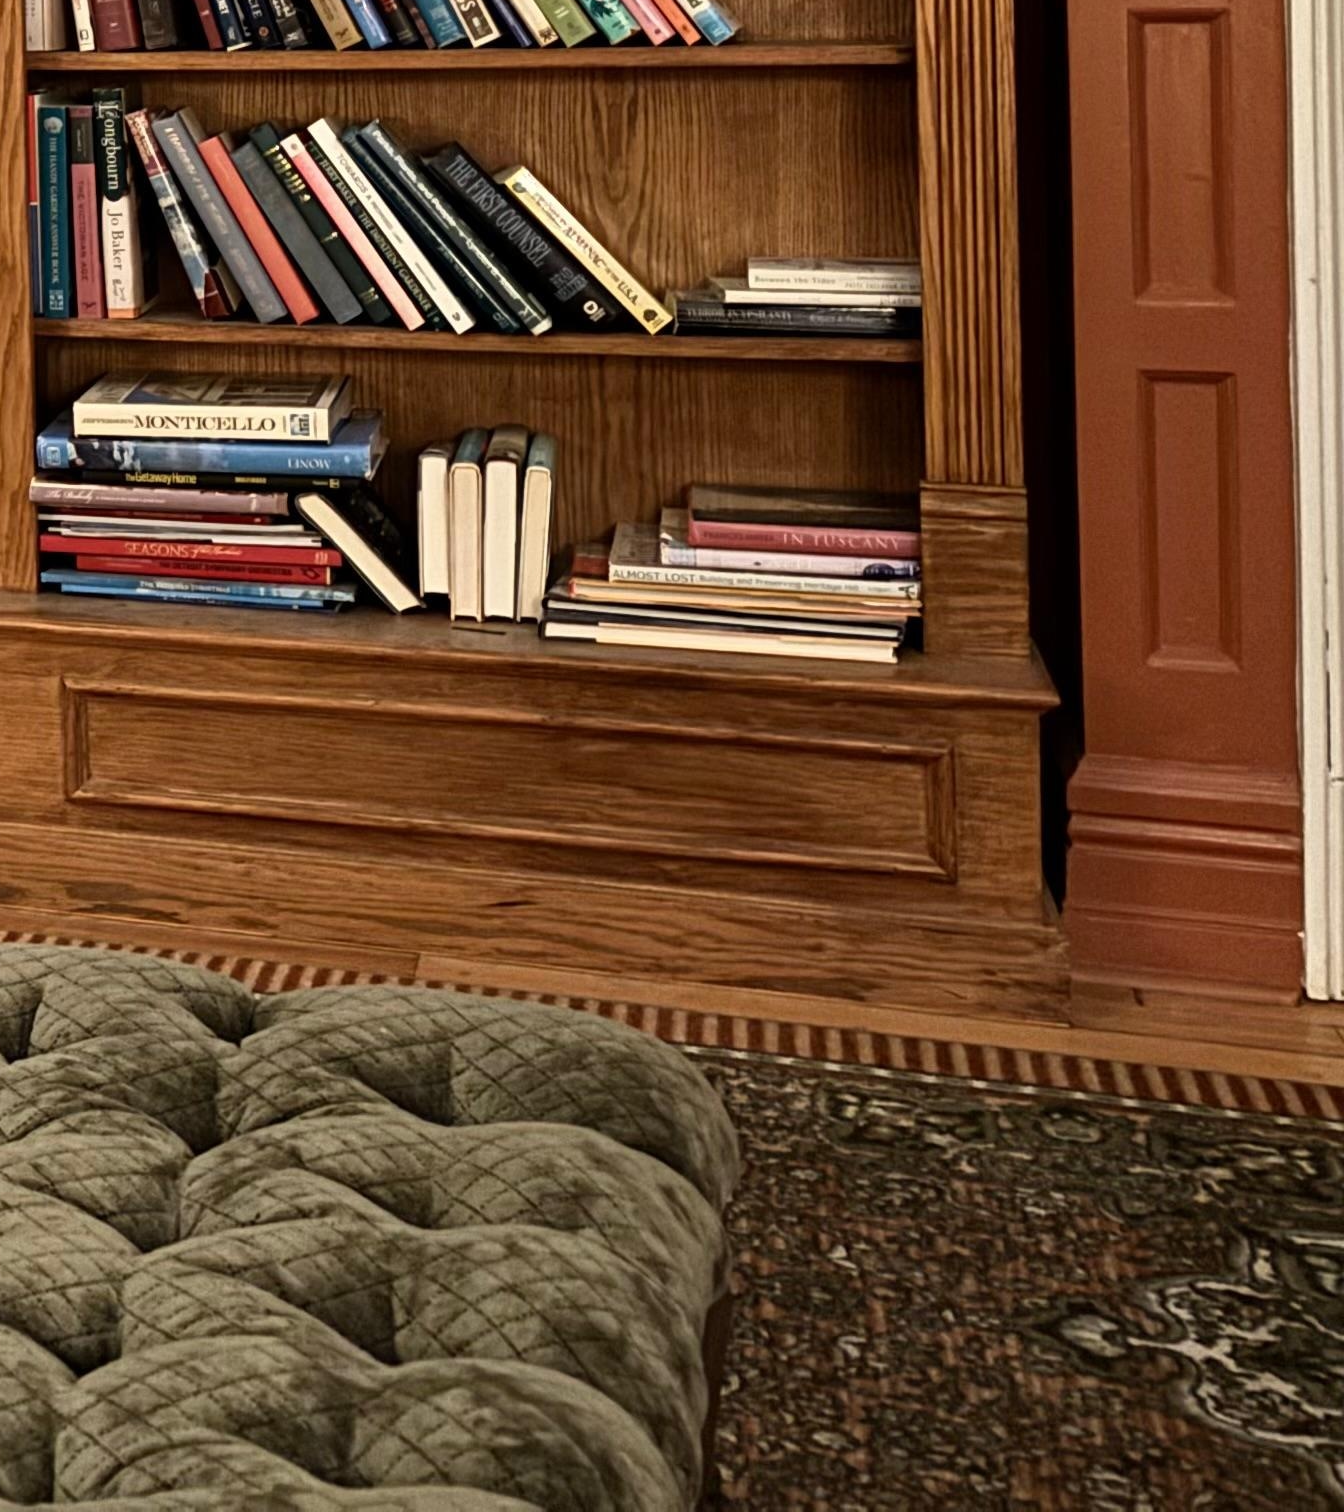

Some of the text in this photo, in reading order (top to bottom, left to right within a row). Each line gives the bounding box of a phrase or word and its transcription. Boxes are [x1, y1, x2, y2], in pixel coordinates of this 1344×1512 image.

[48, 137, 57, 152] THE
[99, 100, 122, 189] Longbourn
[48, 154, 57, 183] HANDY
[49, 185, 58, 220] GARDEN
[443, 153, 478, 188] THE
[464, 175, 508, 220] FIRST
[492, 204, 556, 270] COUNSEL
[77, 202, 87, 258] VICTORIAN
[106, 208, 126, 270] Jo Baker
[50, 258, 59, 284] BOOK
[133, 414, 276, 431] MONTICELLO
[286, 455, 331, 470] MONET
[783, 532, 899, 550] IN TUSCANY
[612, 568, 661, 581] ALMOST
[663, 571, 696, 583] LOST
